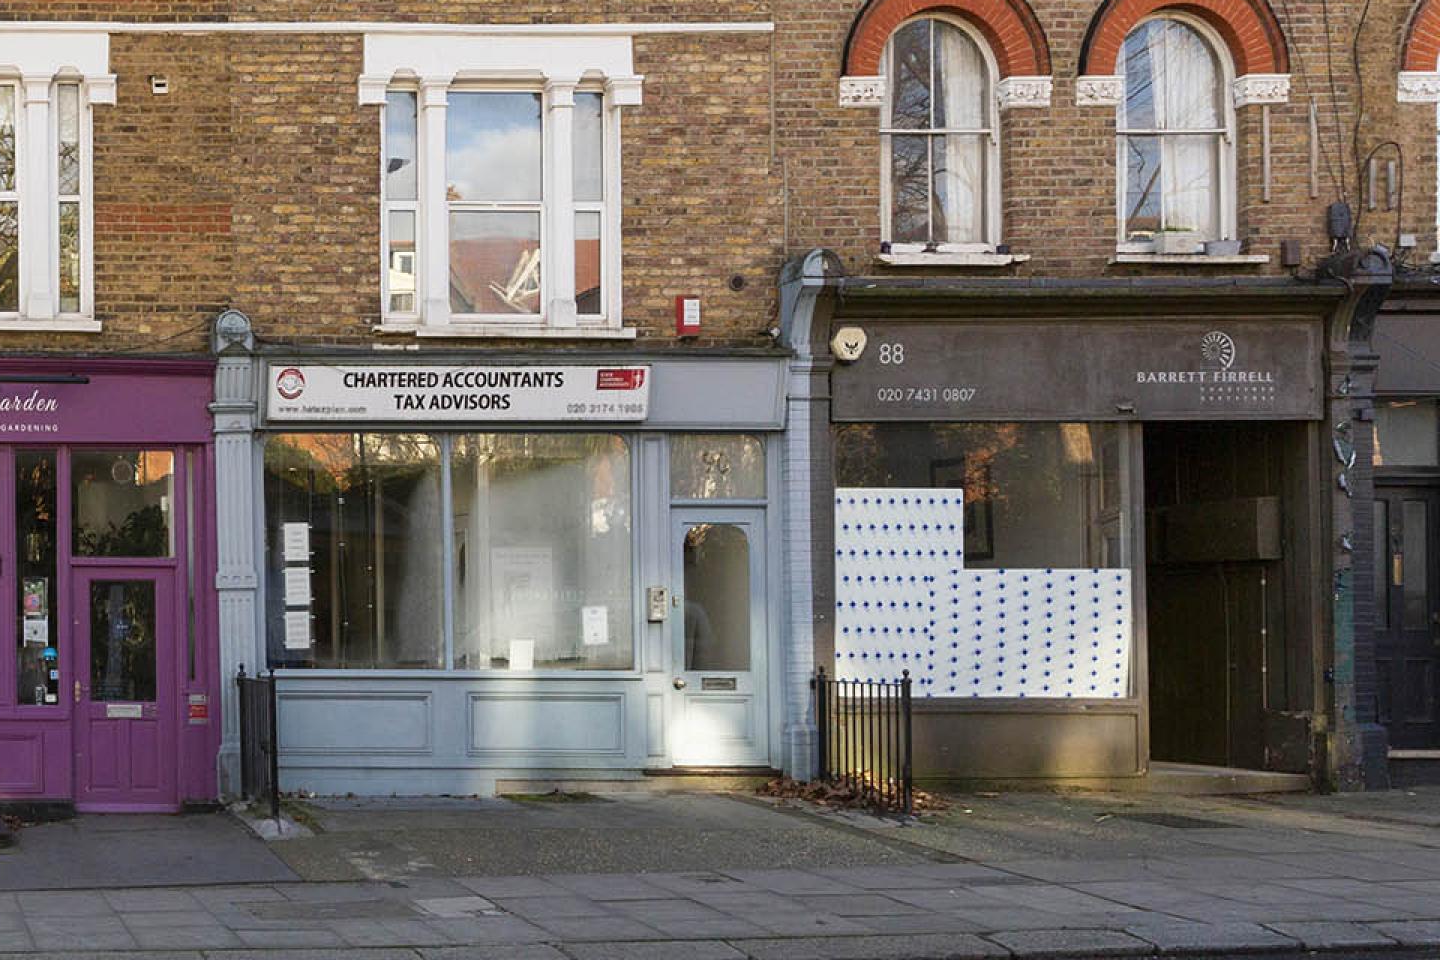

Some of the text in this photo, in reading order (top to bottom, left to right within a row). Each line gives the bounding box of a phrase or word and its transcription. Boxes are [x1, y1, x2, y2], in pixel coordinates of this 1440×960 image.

[879, 343, 904, 364] 88
[343, 372, 564, 388] CHARTERED ACCOUNTANTS
[1136, 370, 1273, 383] BARRETT FIRRELL
[394, 394, 510, 410] TAX ADVISORS
[877, 388, 976, 402] 020 7431 0807
[0, 423, 59, 431] GARDENING
